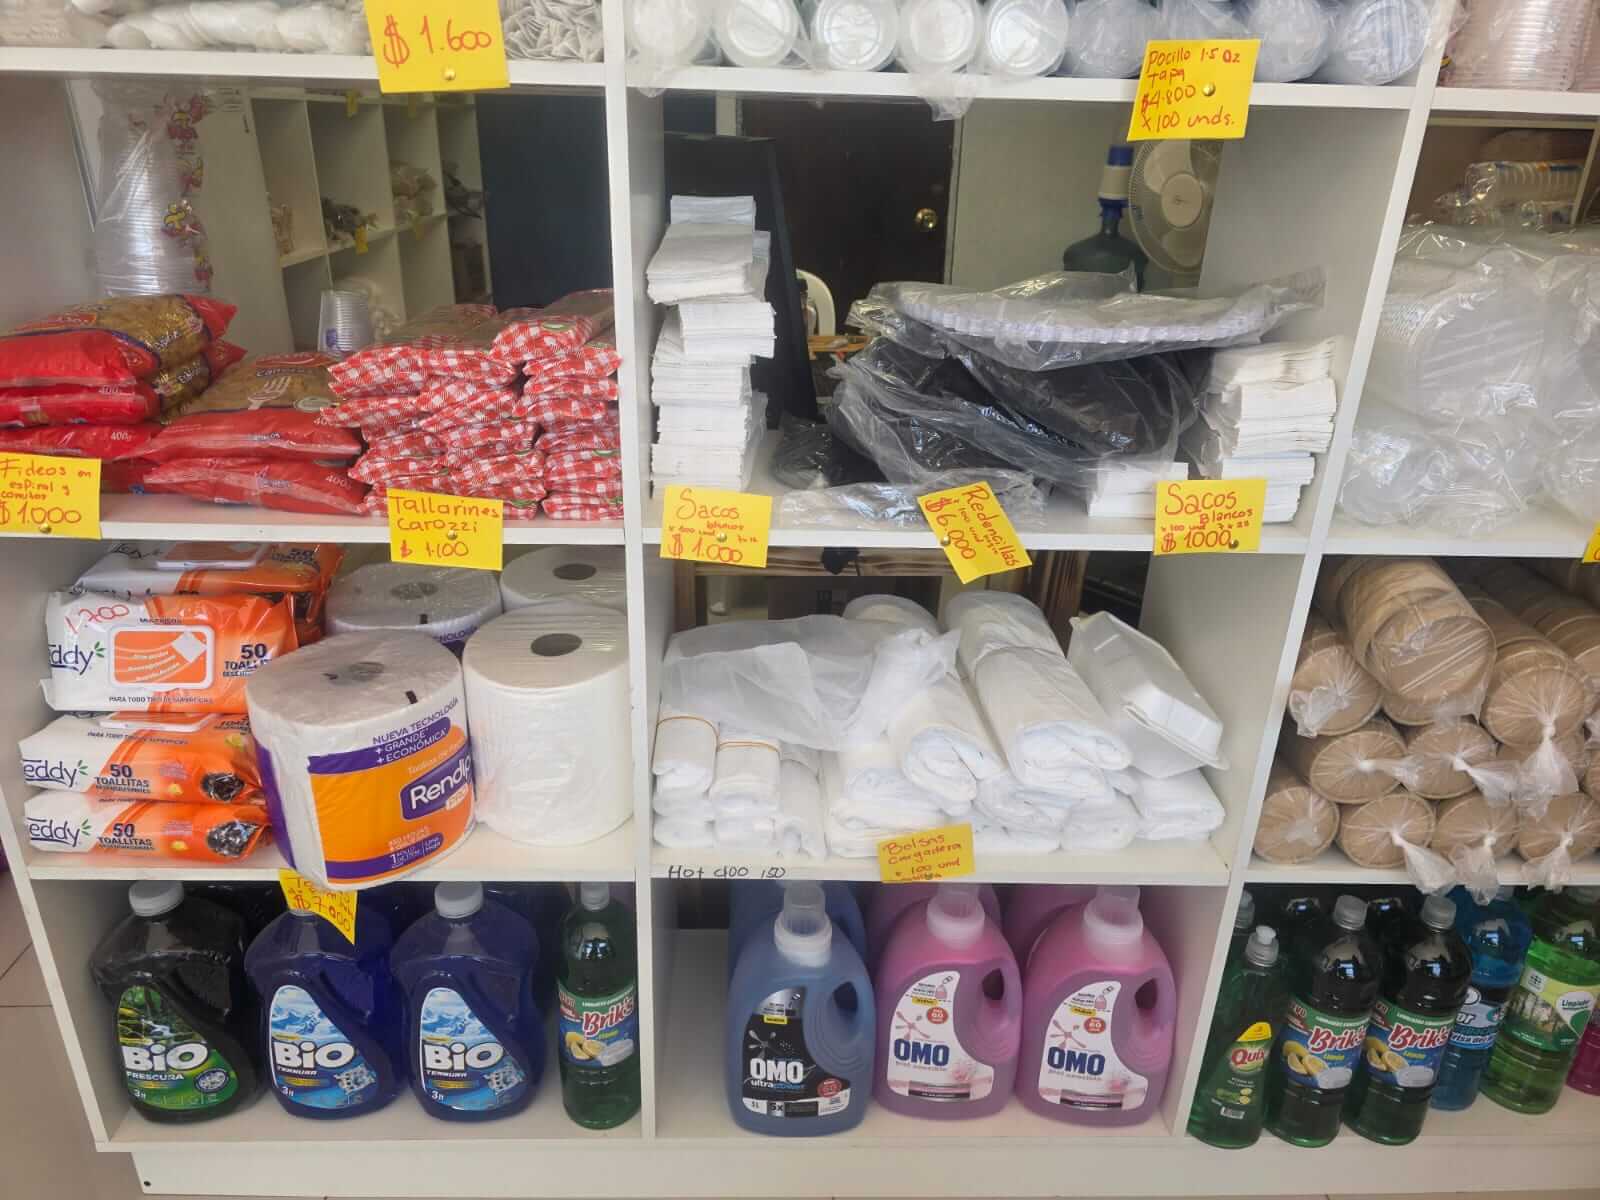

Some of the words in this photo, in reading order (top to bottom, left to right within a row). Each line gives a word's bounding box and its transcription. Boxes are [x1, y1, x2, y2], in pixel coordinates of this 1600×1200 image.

[420, 16, 492, 53] 1.600
[389, 496, 499, 518] Tallarines
[676, 488, 740, 520] Sacos
[1165, 483, 1237, 515] Sacos
[397, 518, 478, 532] Carozzi
[47, 644, 94, 675] ddy
[240, 643, 267, 659] 50
[373, 727, 409, 745] NUEVA
[110, 764, 132, 778] 50
[113, 823, 135, 837] 50
[894, 1038, 950, 1066] OMO
[1047, 1046, 1106, 1076] OMO
[750, 1058, 804, 1084] OMO
